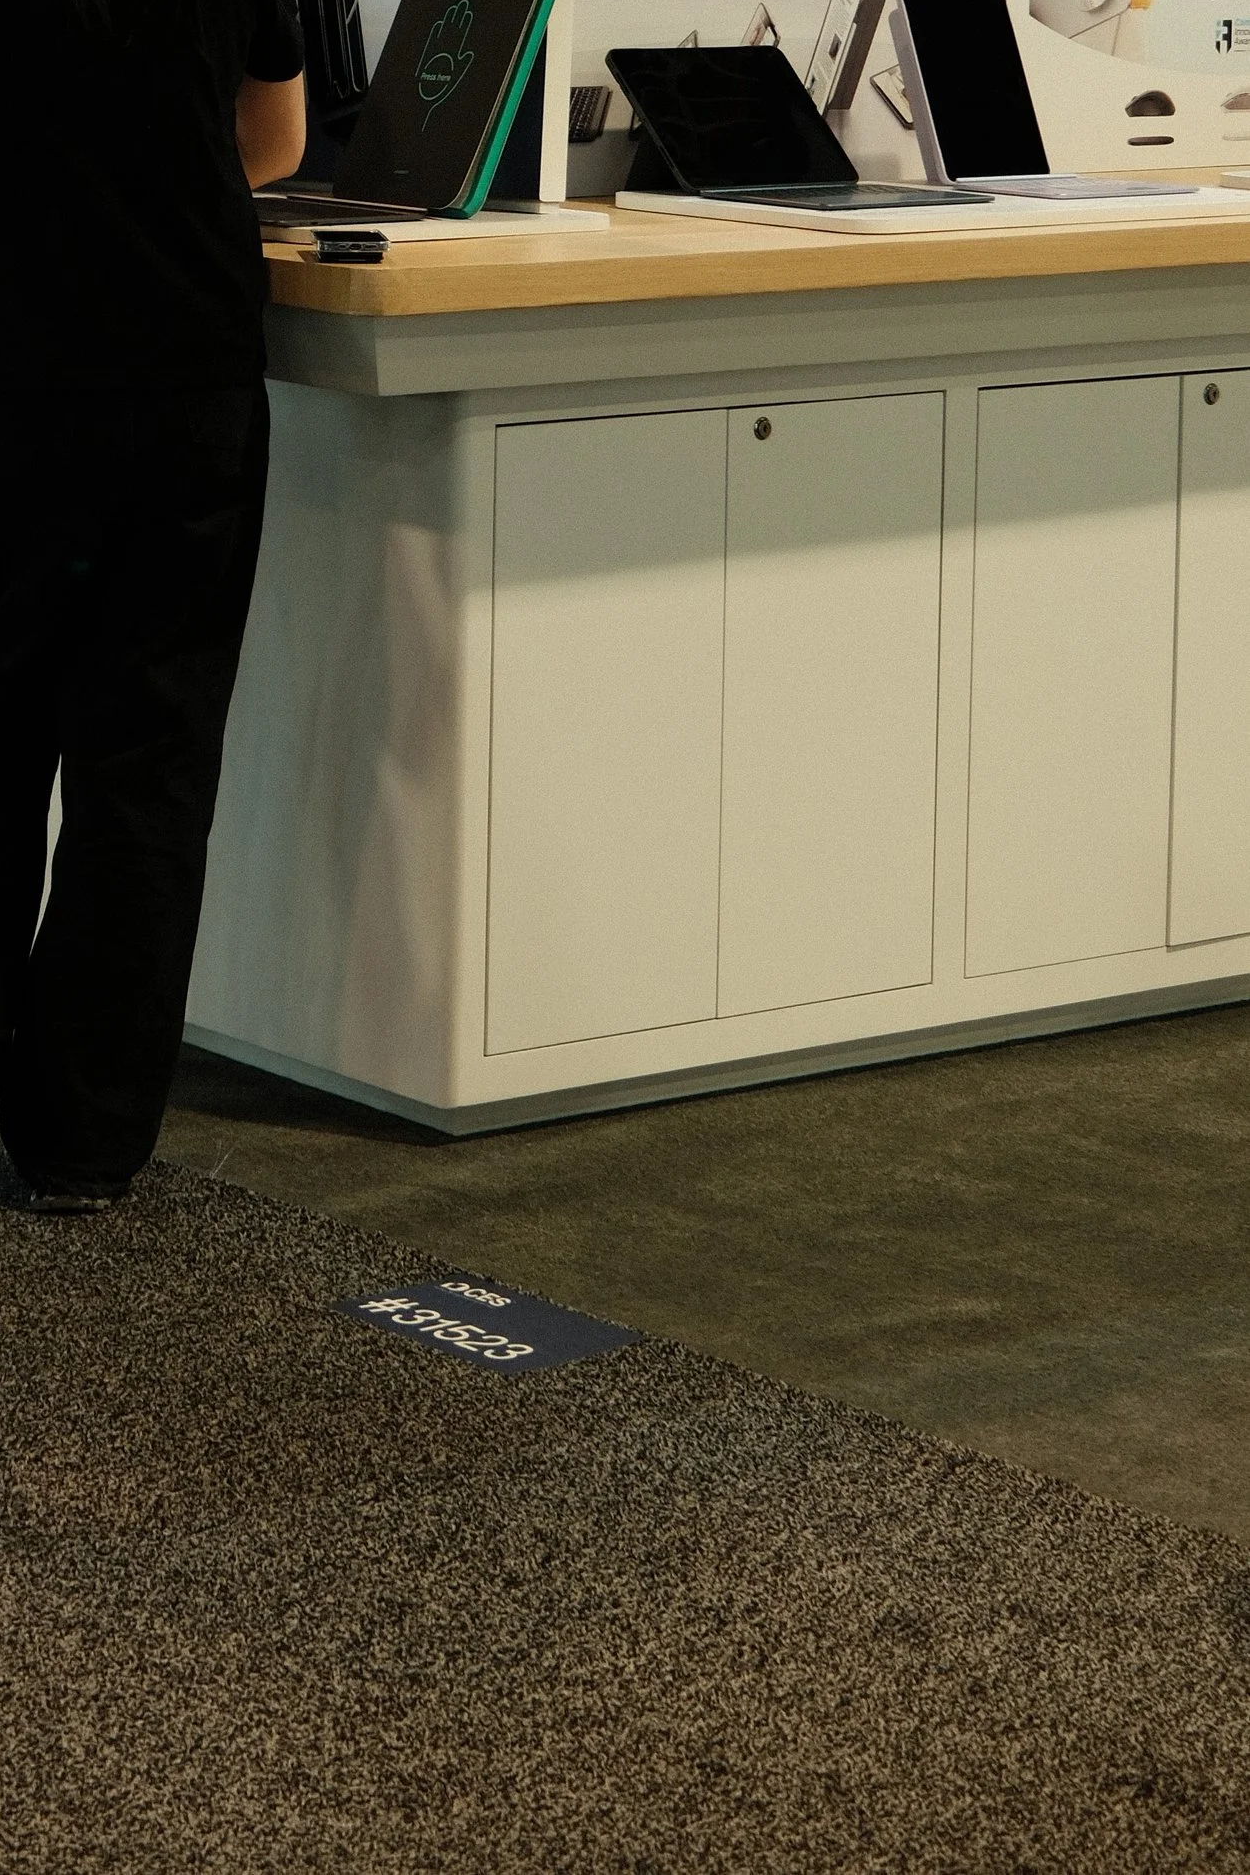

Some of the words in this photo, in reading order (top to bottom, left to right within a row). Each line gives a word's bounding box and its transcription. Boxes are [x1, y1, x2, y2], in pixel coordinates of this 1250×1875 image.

[421, 72, 436, 81] Press
[437, 73, 451, 82] here
[359, 1298, 534, 1360] #31523
